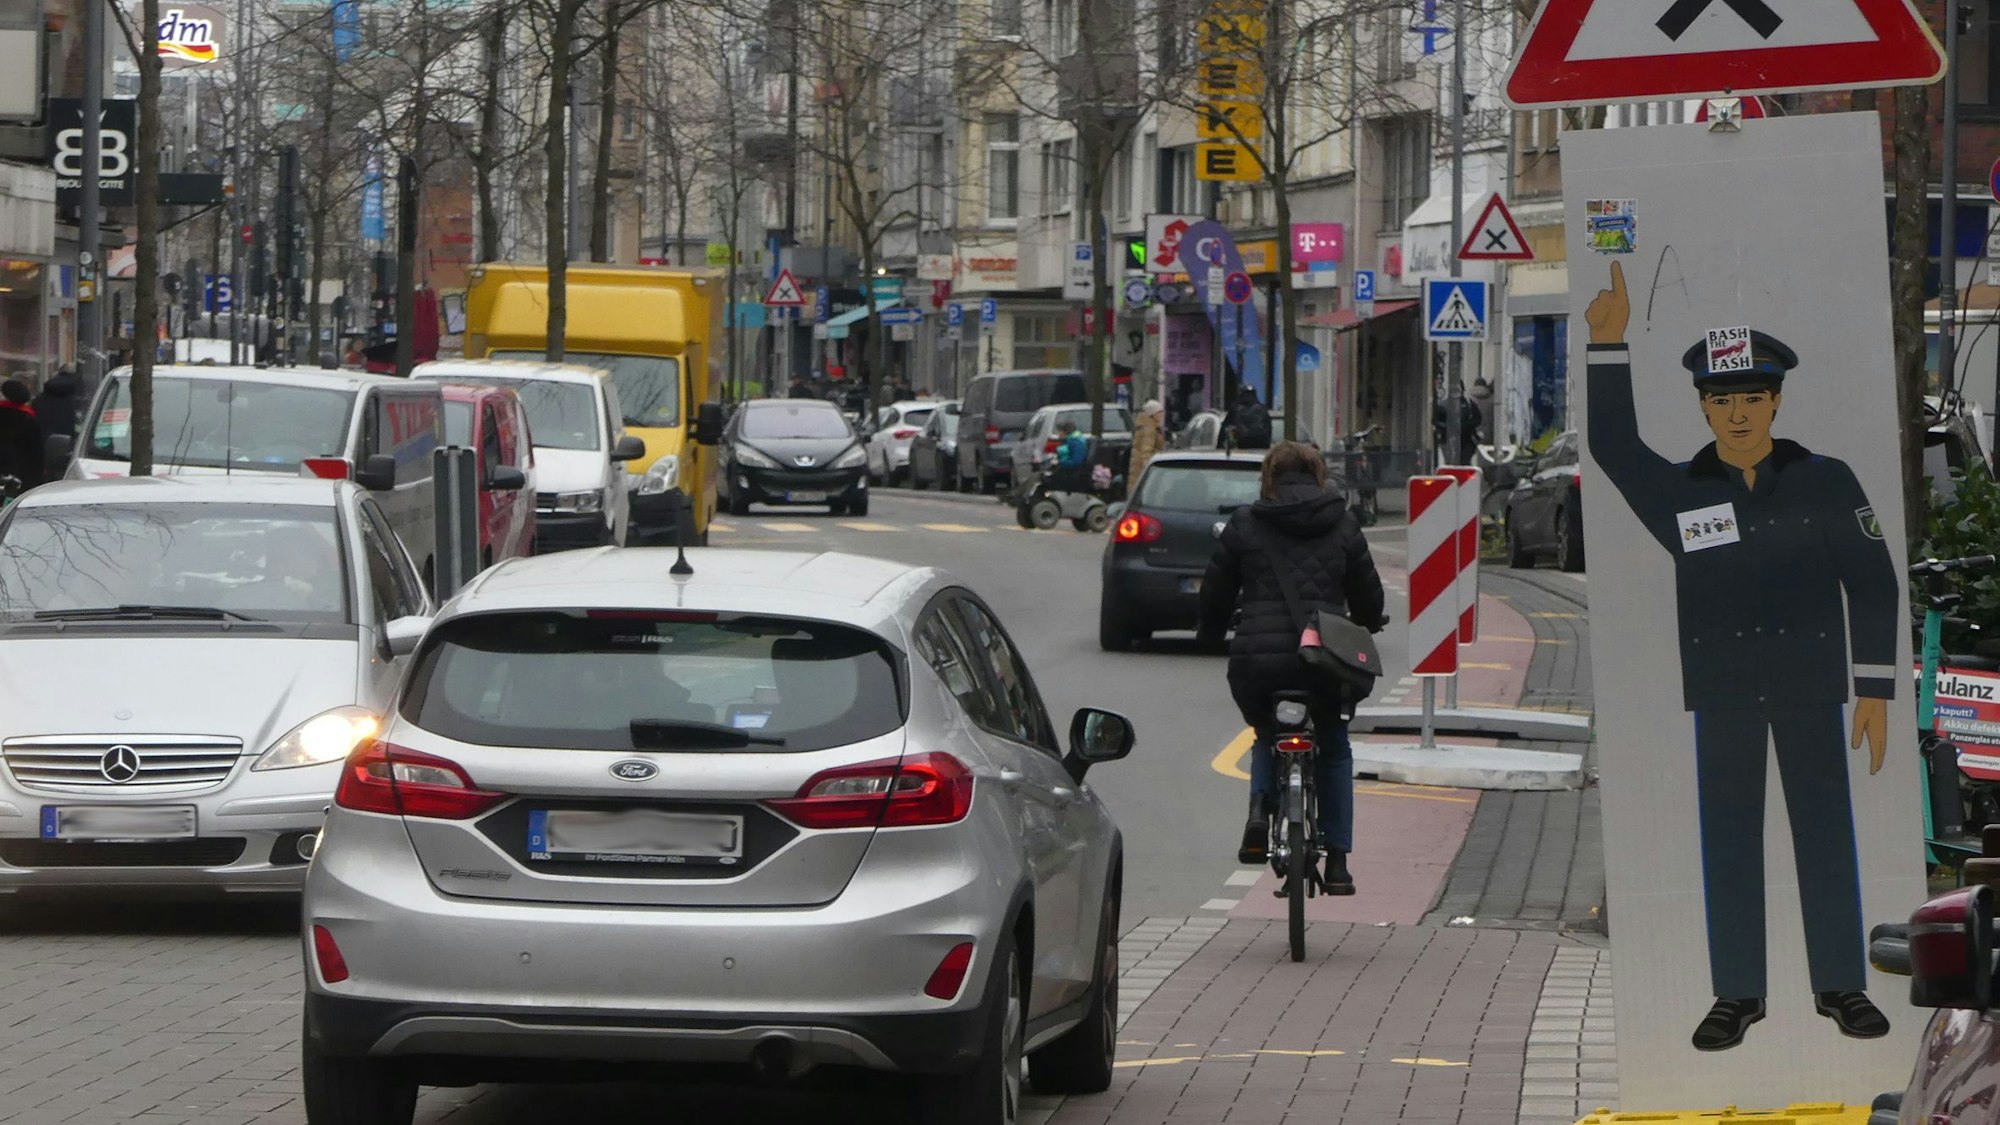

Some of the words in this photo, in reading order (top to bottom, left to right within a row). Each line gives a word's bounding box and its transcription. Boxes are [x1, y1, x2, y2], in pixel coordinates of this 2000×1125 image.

[157, 13, 208, 42] dm
[1357, 273, 1369, 297] P
[1709, 328, 1747, 341] BASH
[1712, 356, 1750, 371] FASH
[1937, 676, 1994, 700] ulanz
[1940, 706, 1974, 718] kaputt?
[1944, 720, 1969, 730] Akku
[620, 764, 648, 777] Ford
[533, 836, 540, 845] D
[637, 855, 666, 864] Partner
[667, 856, 685, 864] Köln
